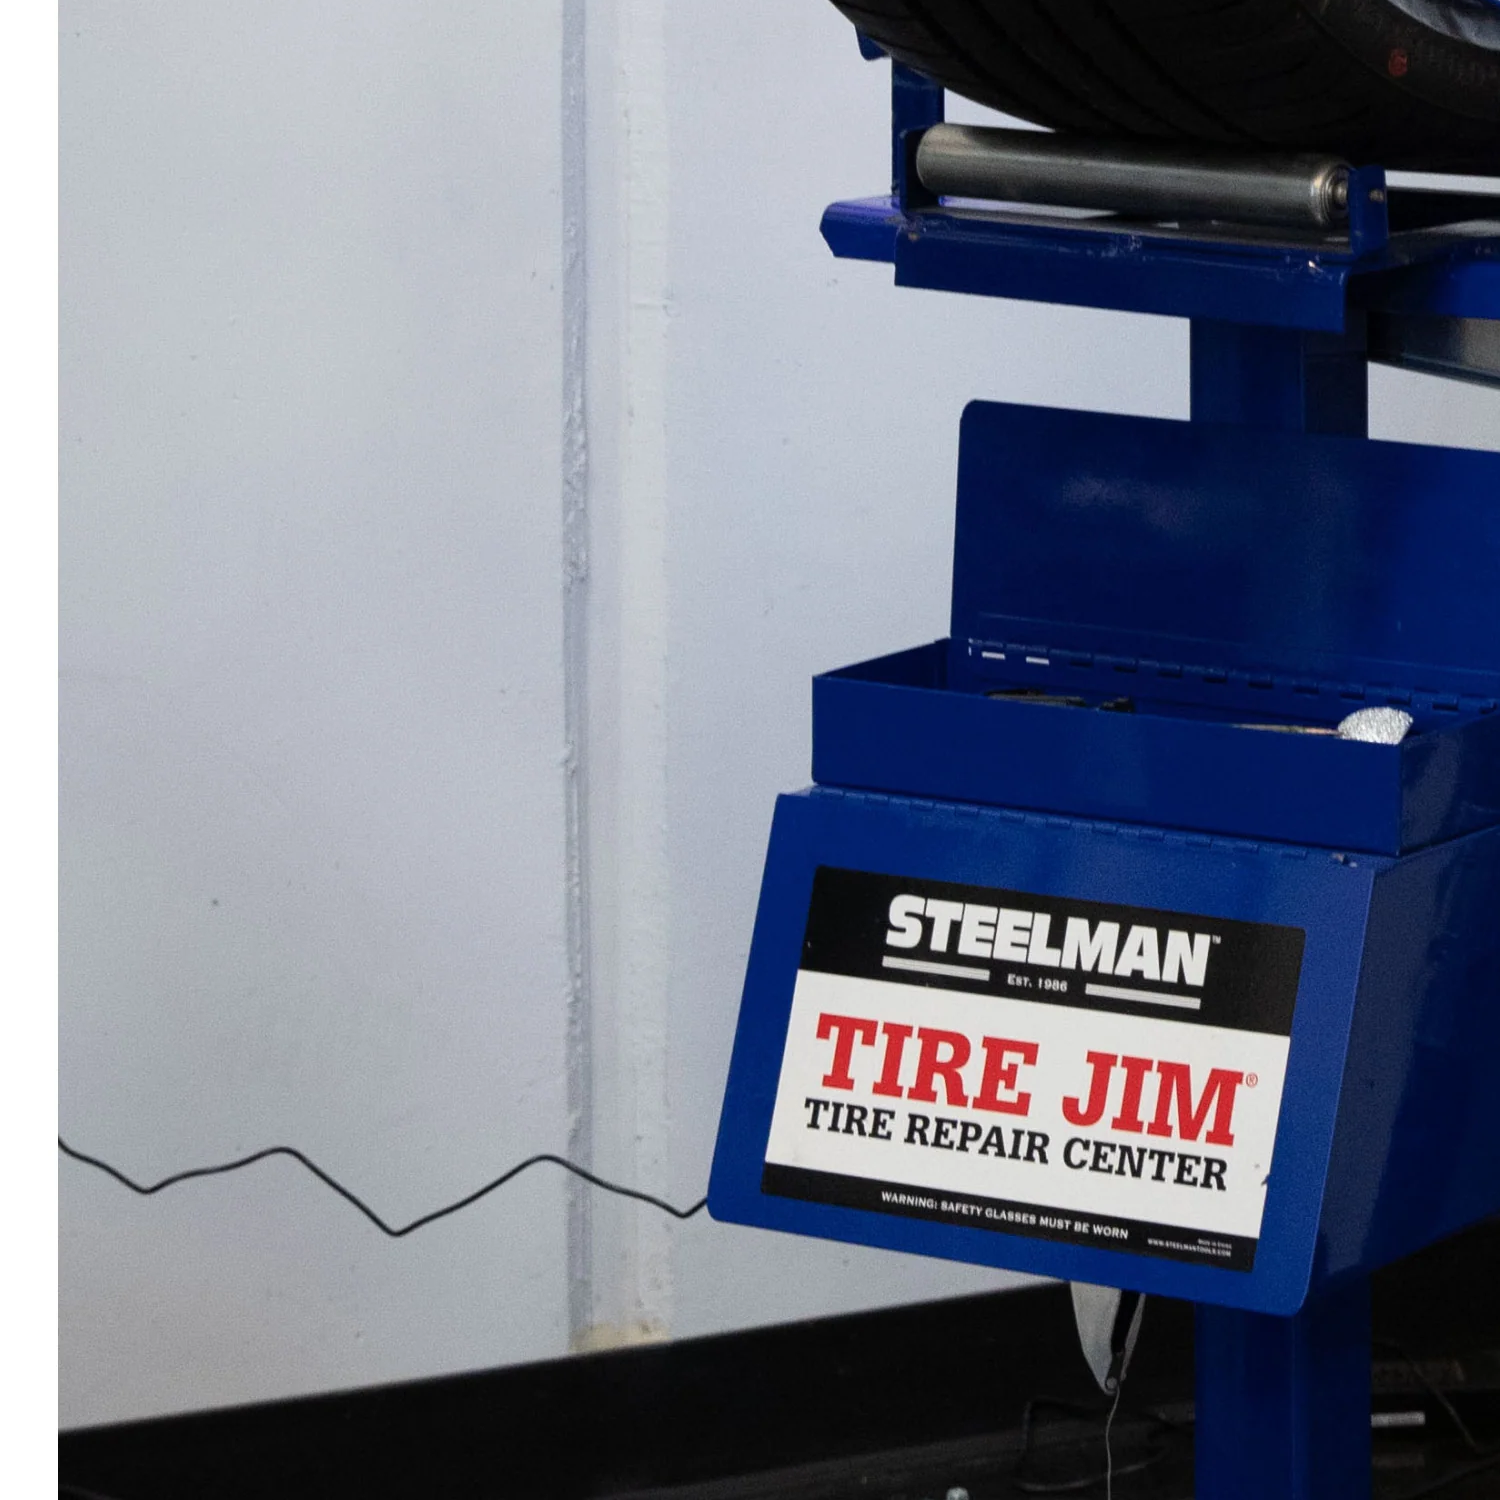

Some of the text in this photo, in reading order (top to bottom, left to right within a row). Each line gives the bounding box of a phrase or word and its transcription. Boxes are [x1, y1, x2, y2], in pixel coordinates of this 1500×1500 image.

[1038, 977, 1068, 993] 1986
[817, 1013, 1244, 1147] TIRE JIM
[804, 1098, 1227, 1191] TIRE REPAIR CENTER
[940, 1200, 983, 1217] SAFETY
[984, 1207, 1037, 1225] GLASSES
[1039, 1215, 1072, 1231] MUST
[1074, 1220, 1090, 1234] BE
[1092, 1224, 1129, 1240] WORN
